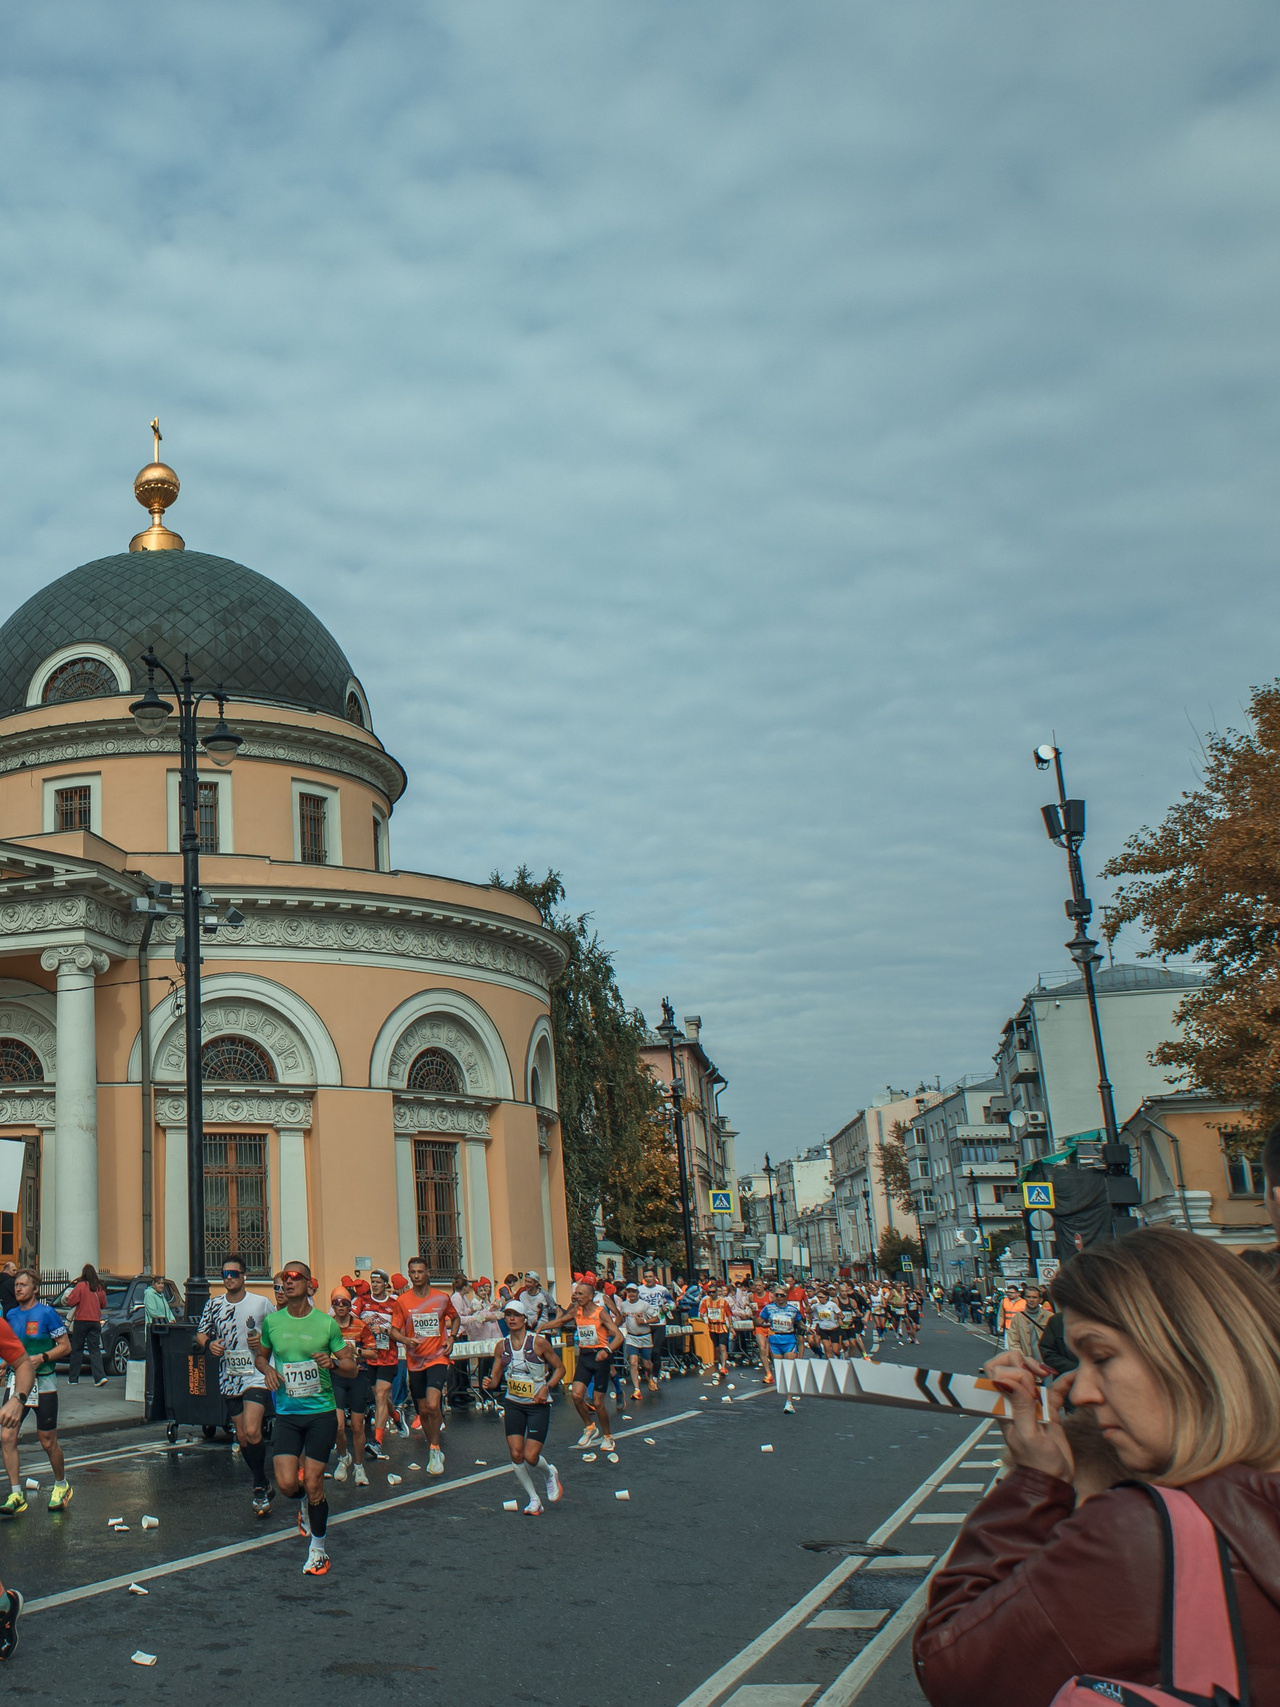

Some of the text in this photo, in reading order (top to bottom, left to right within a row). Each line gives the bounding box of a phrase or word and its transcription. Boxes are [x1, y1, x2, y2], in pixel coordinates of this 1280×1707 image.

[414, 1318, 439, 1328] 20022
[226, 1357, 252, 1366] 13304
[285, 1368, 318, 1383] 17180
[509, 1381, 532, 1393] 16661
